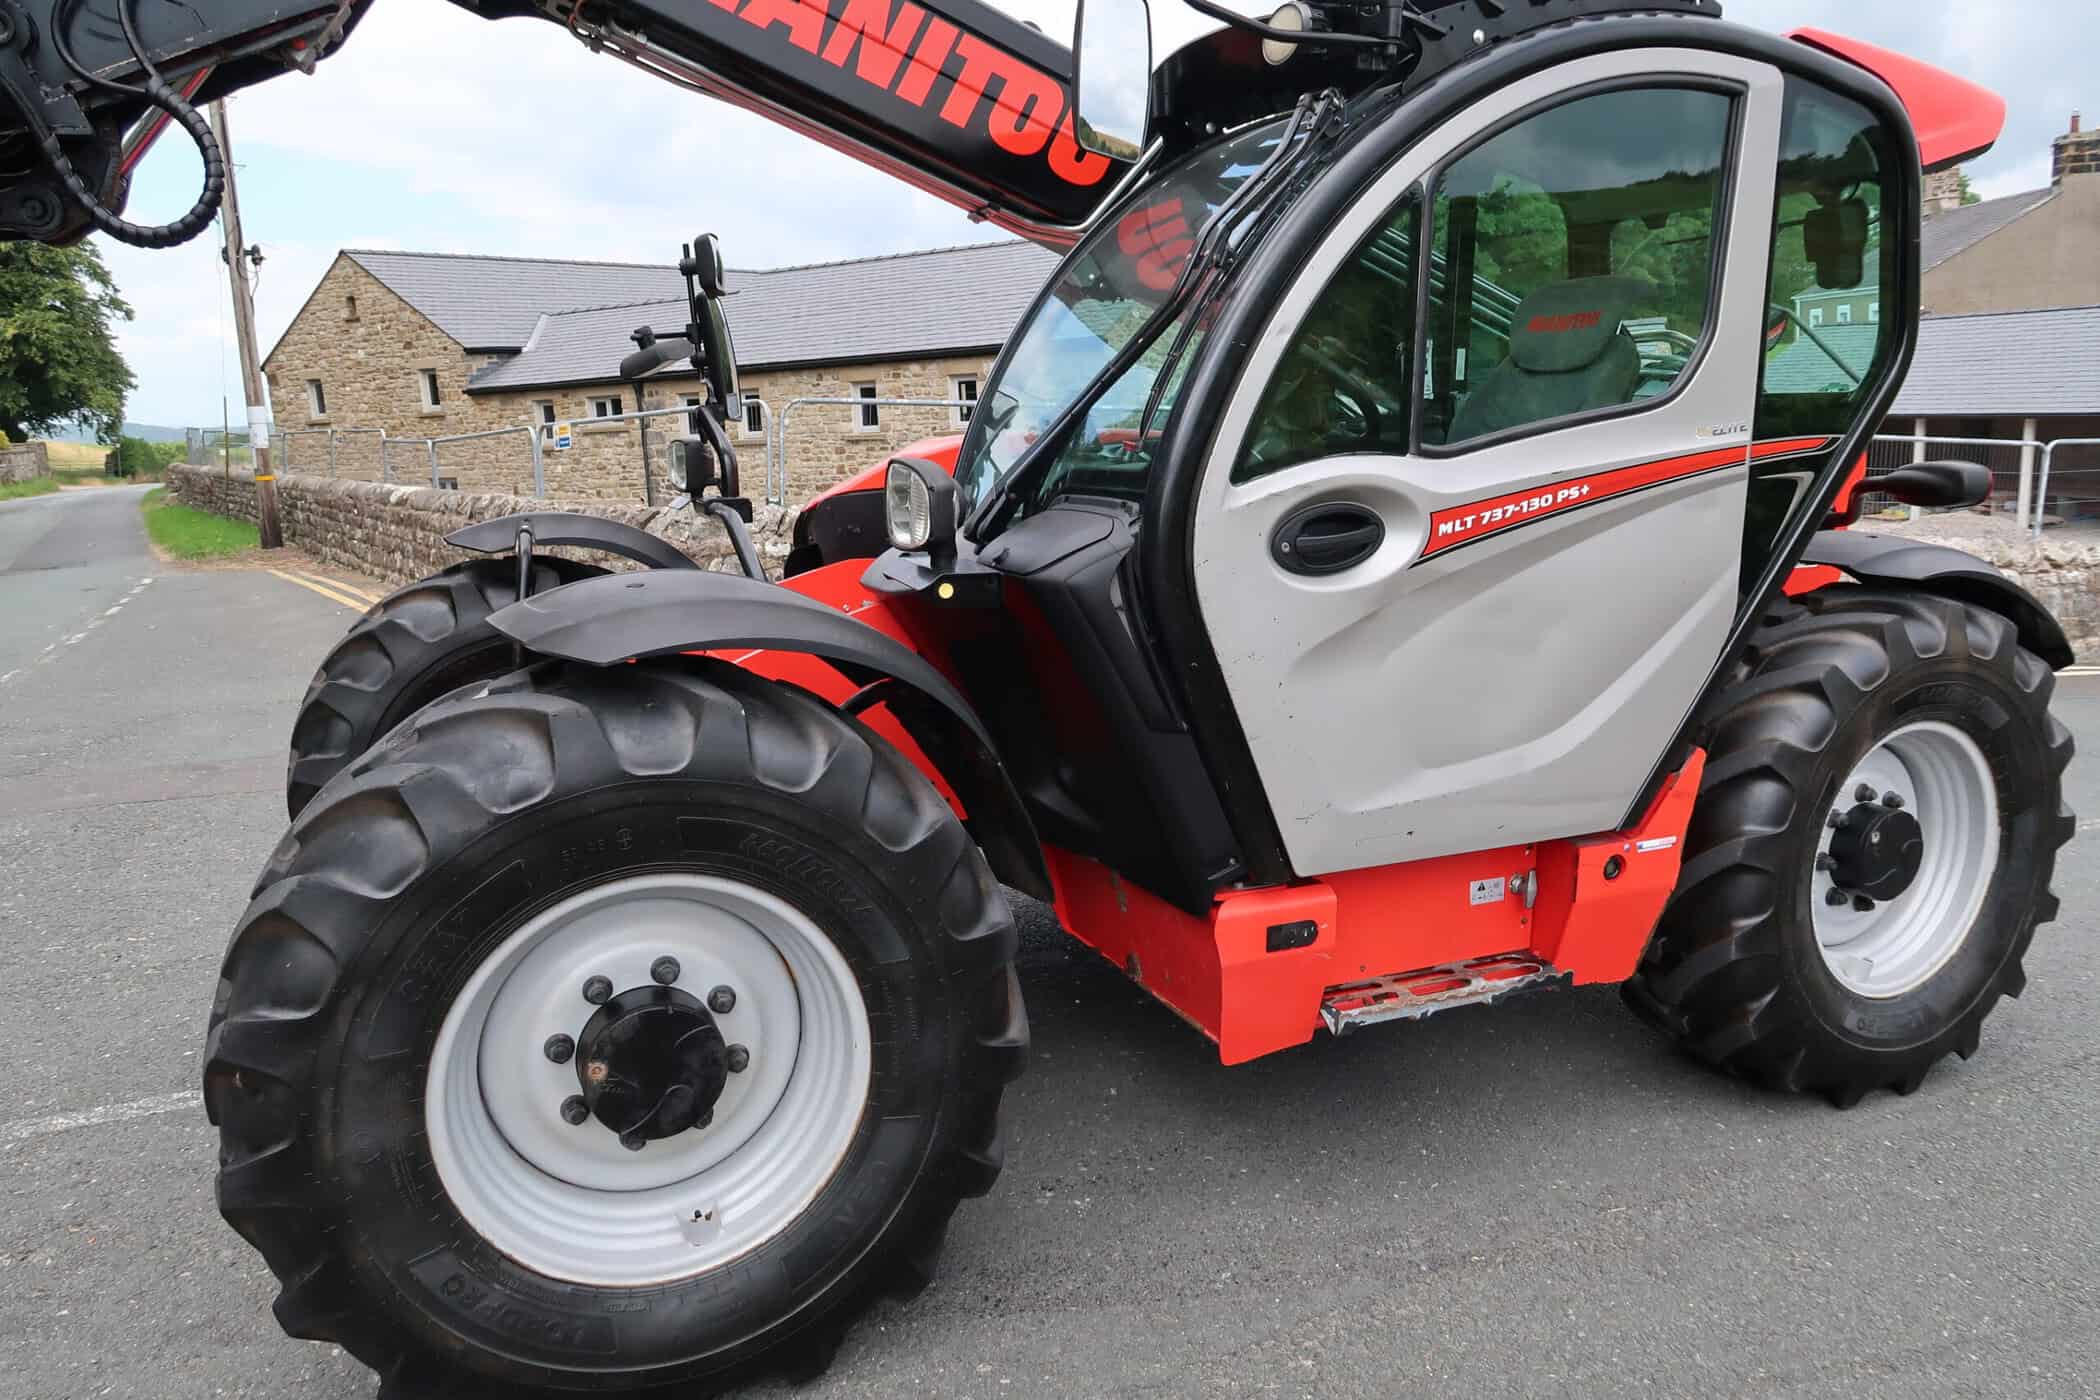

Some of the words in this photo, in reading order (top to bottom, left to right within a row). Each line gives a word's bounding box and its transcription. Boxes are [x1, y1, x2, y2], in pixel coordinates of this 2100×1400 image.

[706, 0, 1112, 187] ANITO
[1438, 514, 1477, 537] MLT
[1480, 493, 1553, 526] 737-130
[1557, 484, 1590, 504] PS+
